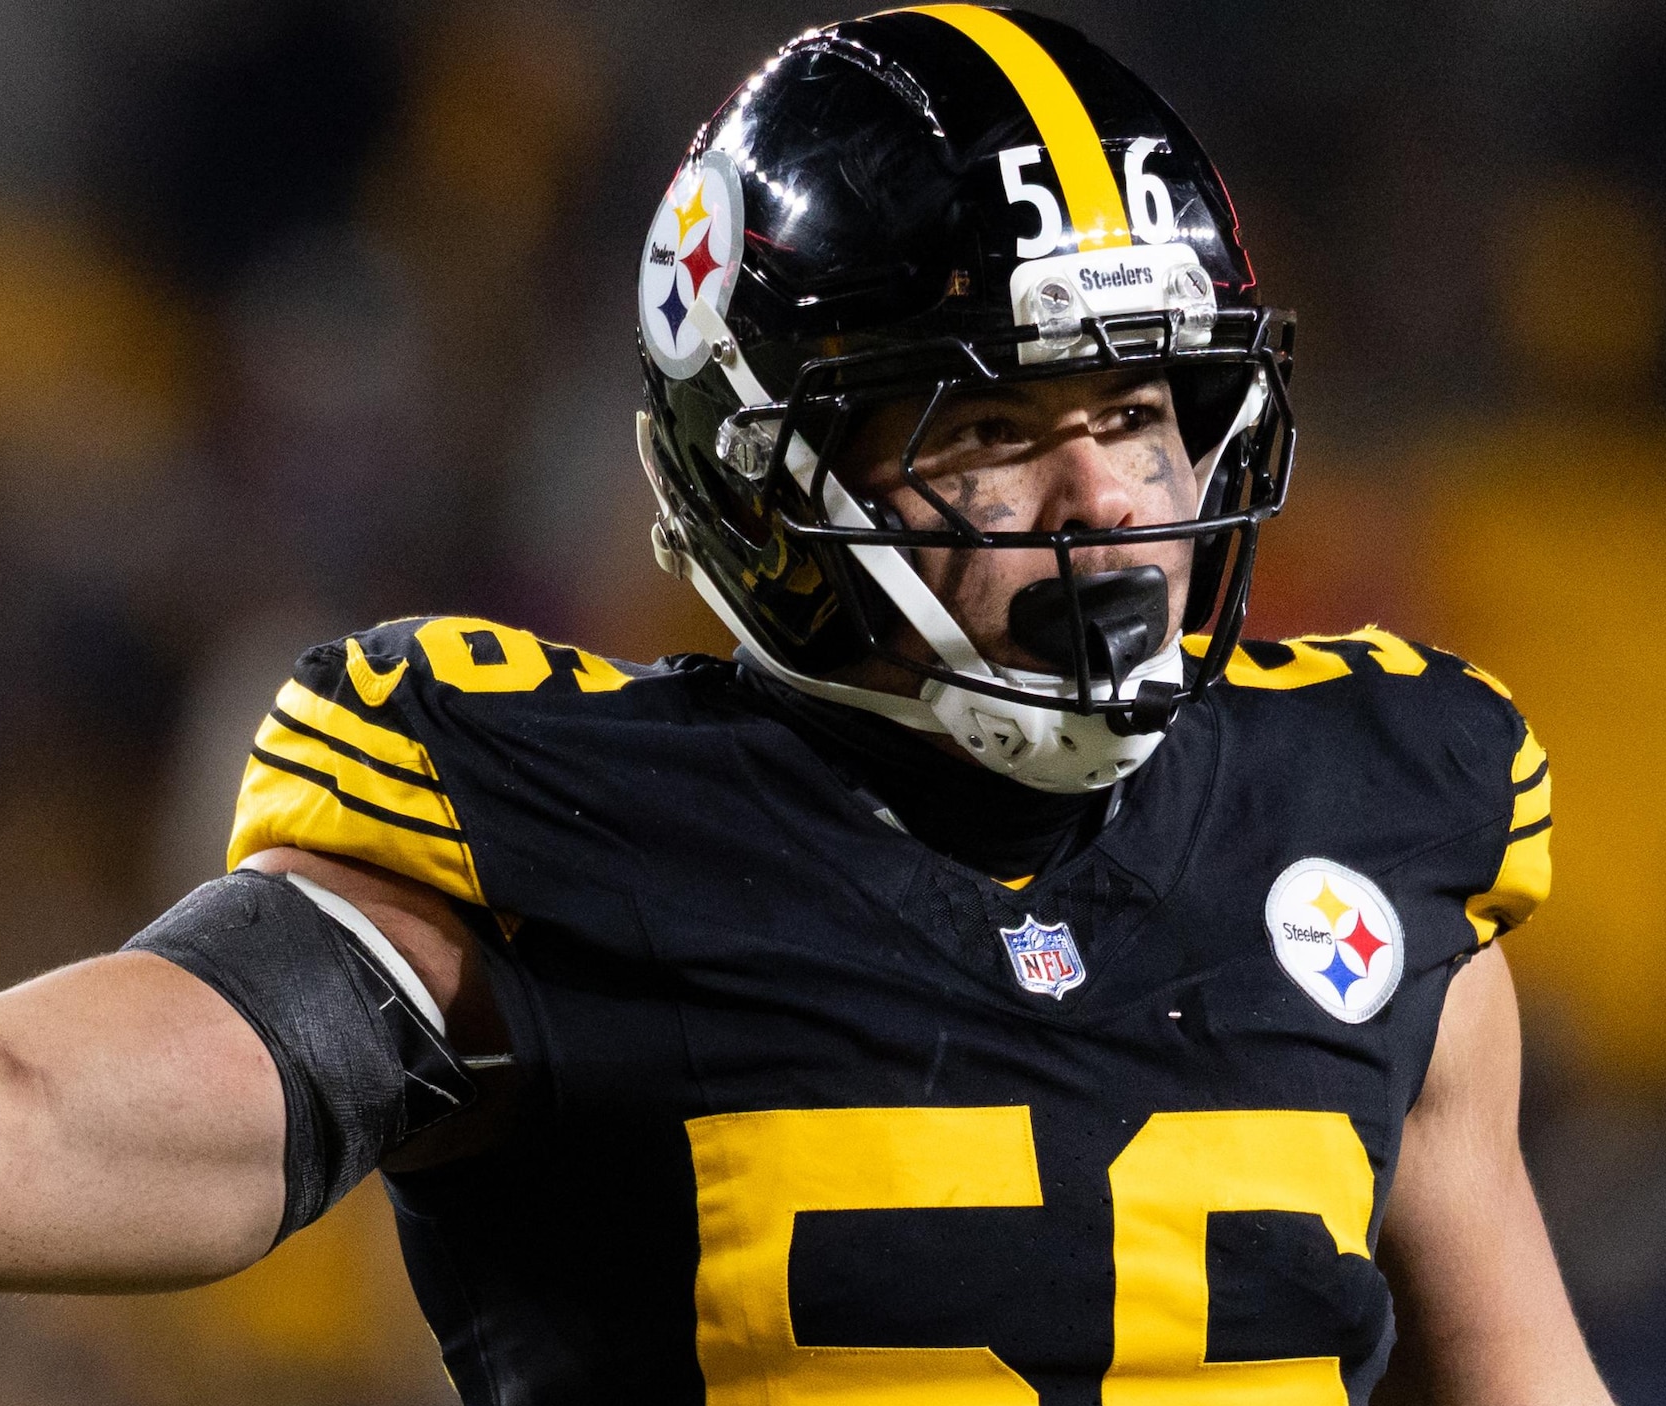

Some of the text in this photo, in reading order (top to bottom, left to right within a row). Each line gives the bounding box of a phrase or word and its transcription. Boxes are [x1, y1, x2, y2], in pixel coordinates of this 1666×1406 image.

[1079, 263, 1153, 291] Steelers
[1283, 922, 1333, 945] Steelers
[1019, 950, 1073, 982] NFL
